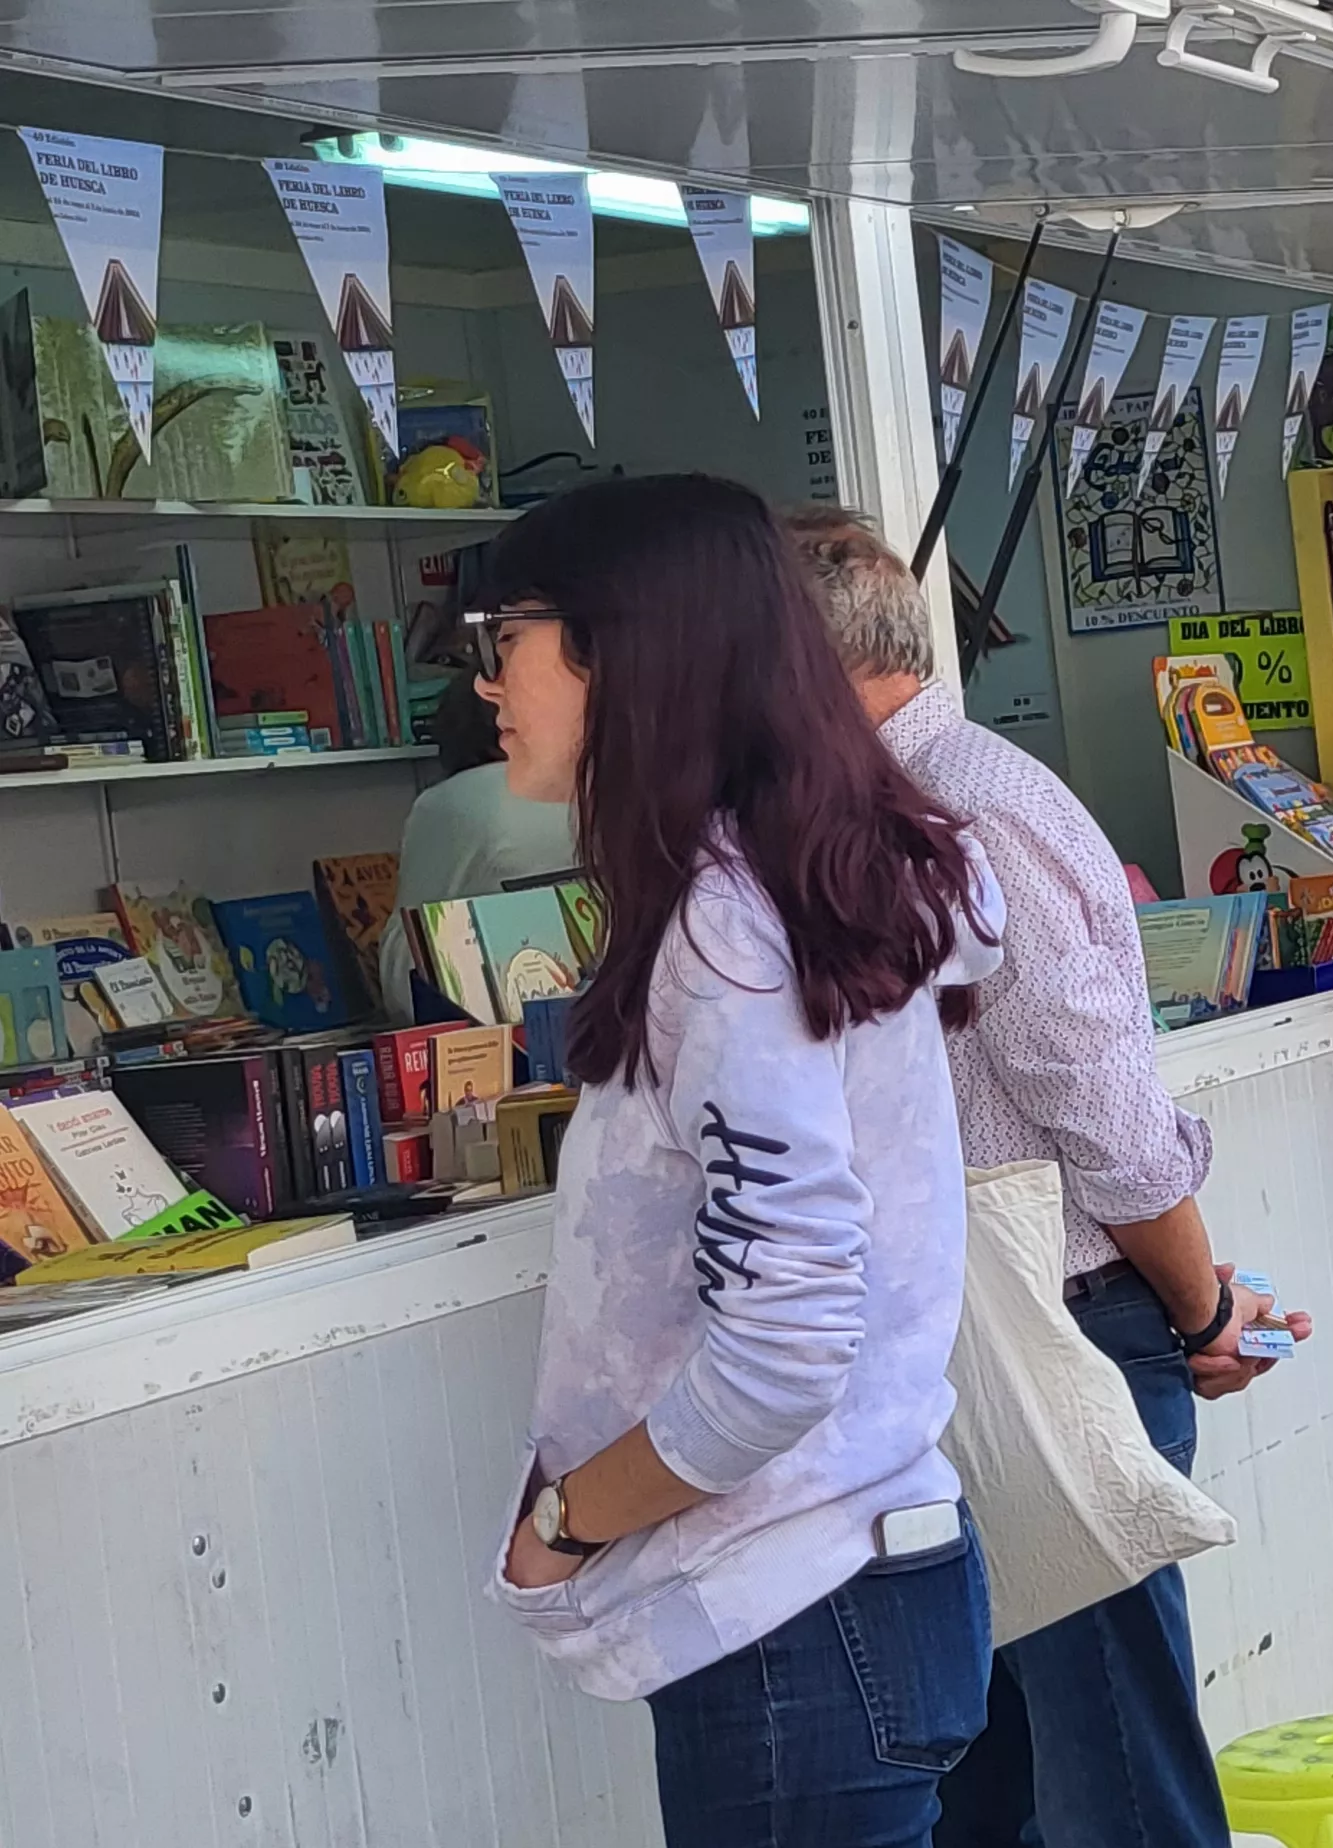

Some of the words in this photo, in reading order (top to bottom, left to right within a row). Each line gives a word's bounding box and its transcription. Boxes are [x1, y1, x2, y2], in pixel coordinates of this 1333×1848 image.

[36, 152, 75, 169] FERIA
[77, 158, 99, 174] DEL
[101, 163, 138, 181] LIBRO
[40, 172, 58, 186] DE
[60, 175, 106, 195] HUESCA
[1117, 604, 1201, 624] DESCUENTO
[1180, 621, 1209, 640] DIA
[1218, 619, 1251, 638] DEL
[356, 863, 393, 882] AVES
